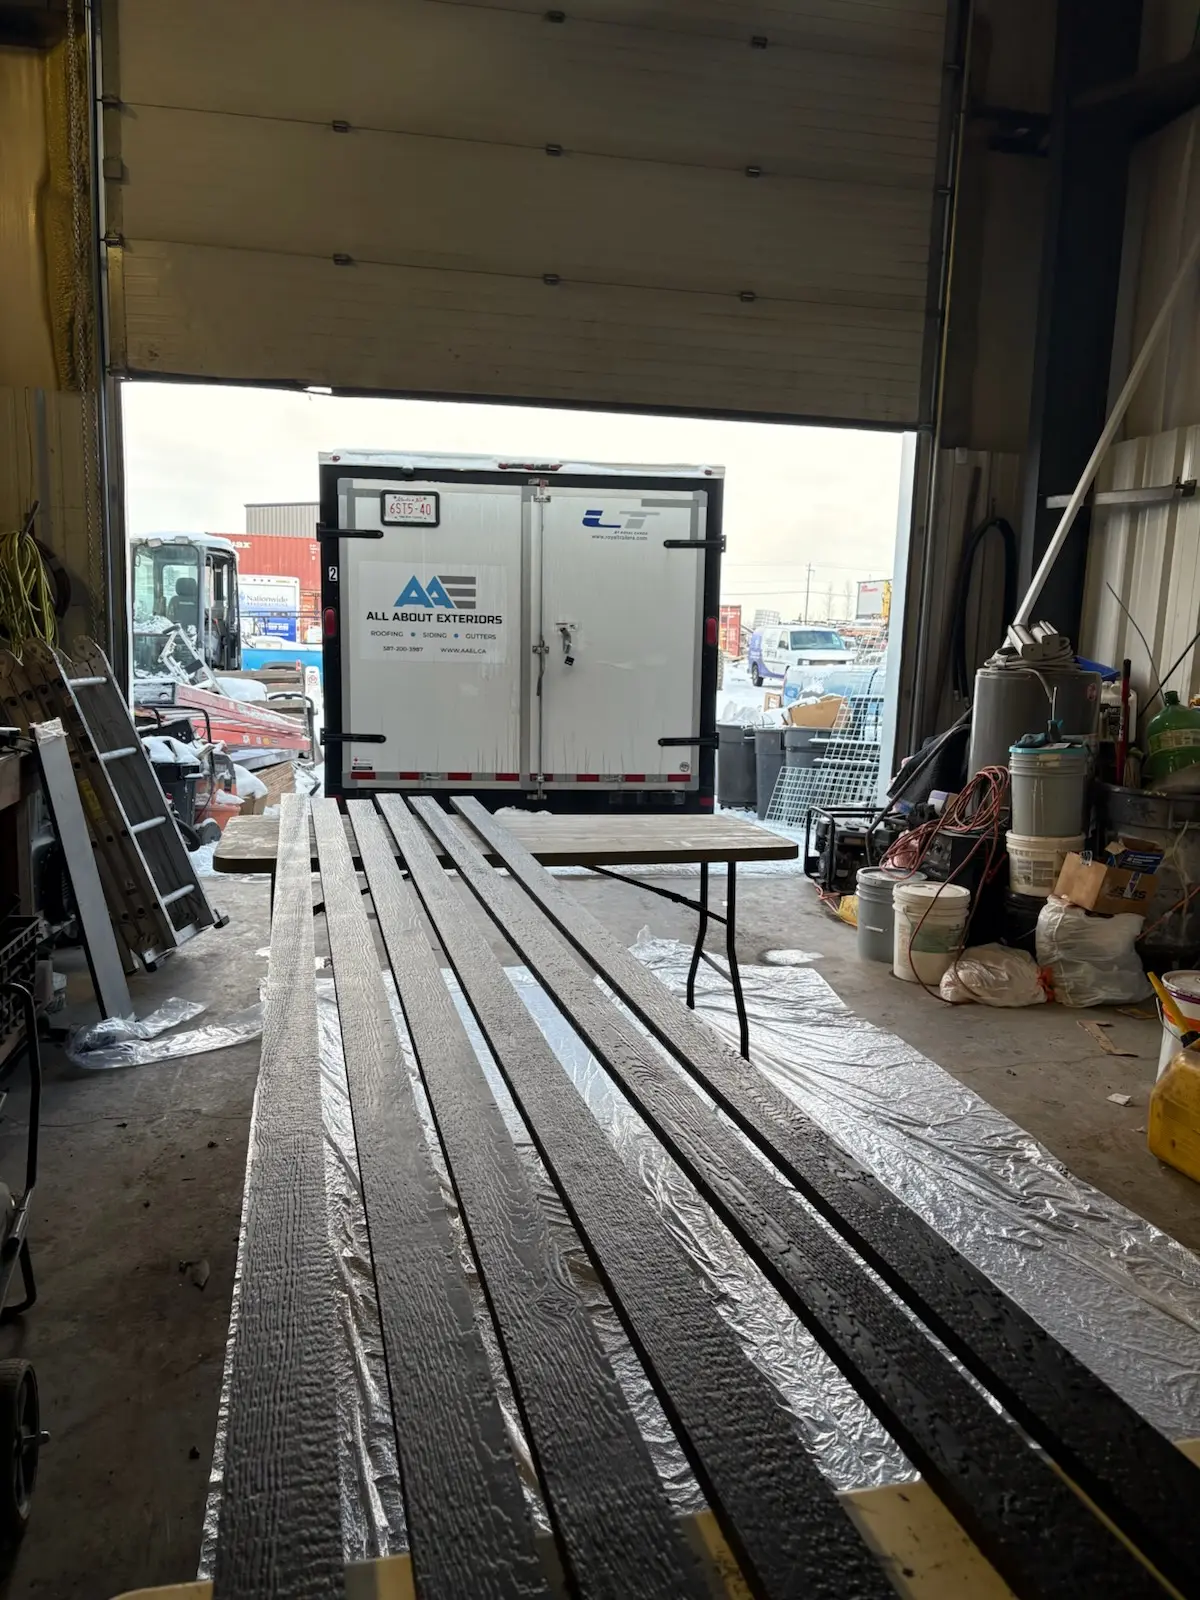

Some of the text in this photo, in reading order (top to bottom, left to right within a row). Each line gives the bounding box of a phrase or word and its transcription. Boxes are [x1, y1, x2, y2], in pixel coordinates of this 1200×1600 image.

[389, 503, 431, 515] 6ST5-40
[330, 567, 336, 580] 2
[366, 611, 503, 625] ALL ABOUT EXTERIORS
